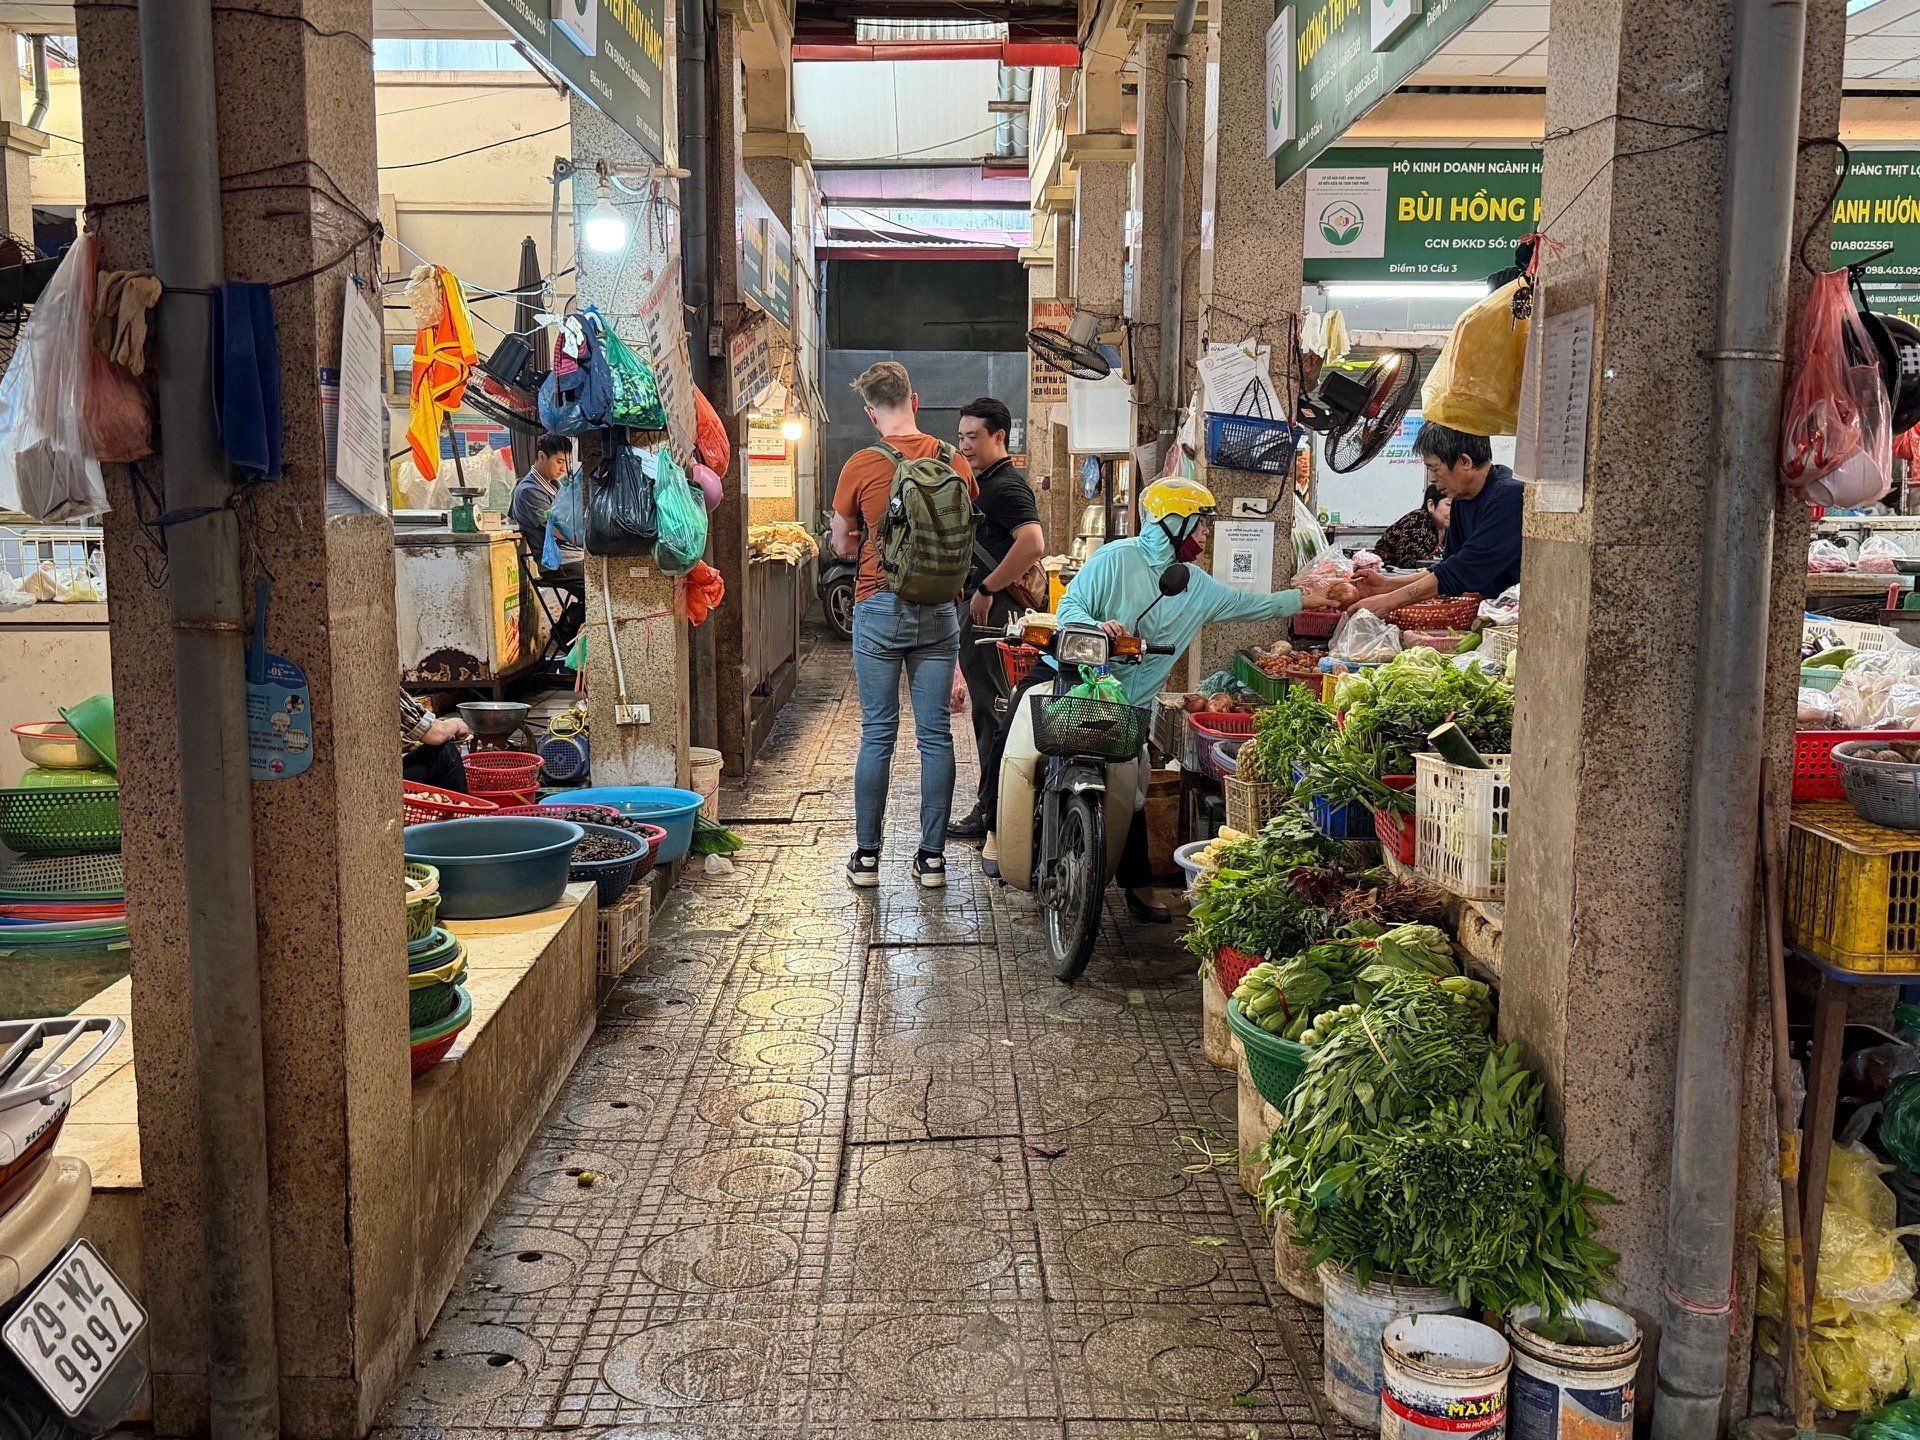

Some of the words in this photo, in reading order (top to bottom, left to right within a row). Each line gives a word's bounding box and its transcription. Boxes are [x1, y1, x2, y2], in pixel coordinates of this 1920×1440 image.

[1393, 159, 1409, 176] HỘ
[1412, 162, 1441, 173] KINH
[1443, 162, 1486, 173] DOANH
[1488, 160, 1530, 174] NGÀNH
[1850, 162, 1883, 176] HÀNG
[1884, 164, 1909, 178] THỊT
[1398, 190, 1443, 222] BÙI
[1449, 188, 1526, 223] HỒNG
[1831, 200, 1871, 223] ANH
[1424, 238, 1450, 249] GCN
[1452, 238, 1487, 249] ĐKKD
[1488, 235, 1508, 249] SỐ:
[1389, 262, 1414, 273] Điểm
[1418, 264, 1428, 273] 10
[1430, 262, 1449, 273] Cầu
[1451, 264, 1458, 273] 3
[25, 1101, 66, 1146] HONDA
[20, 1257, 104, 1359] 29-M2
[54, 1296, 133, 1394] 9992
